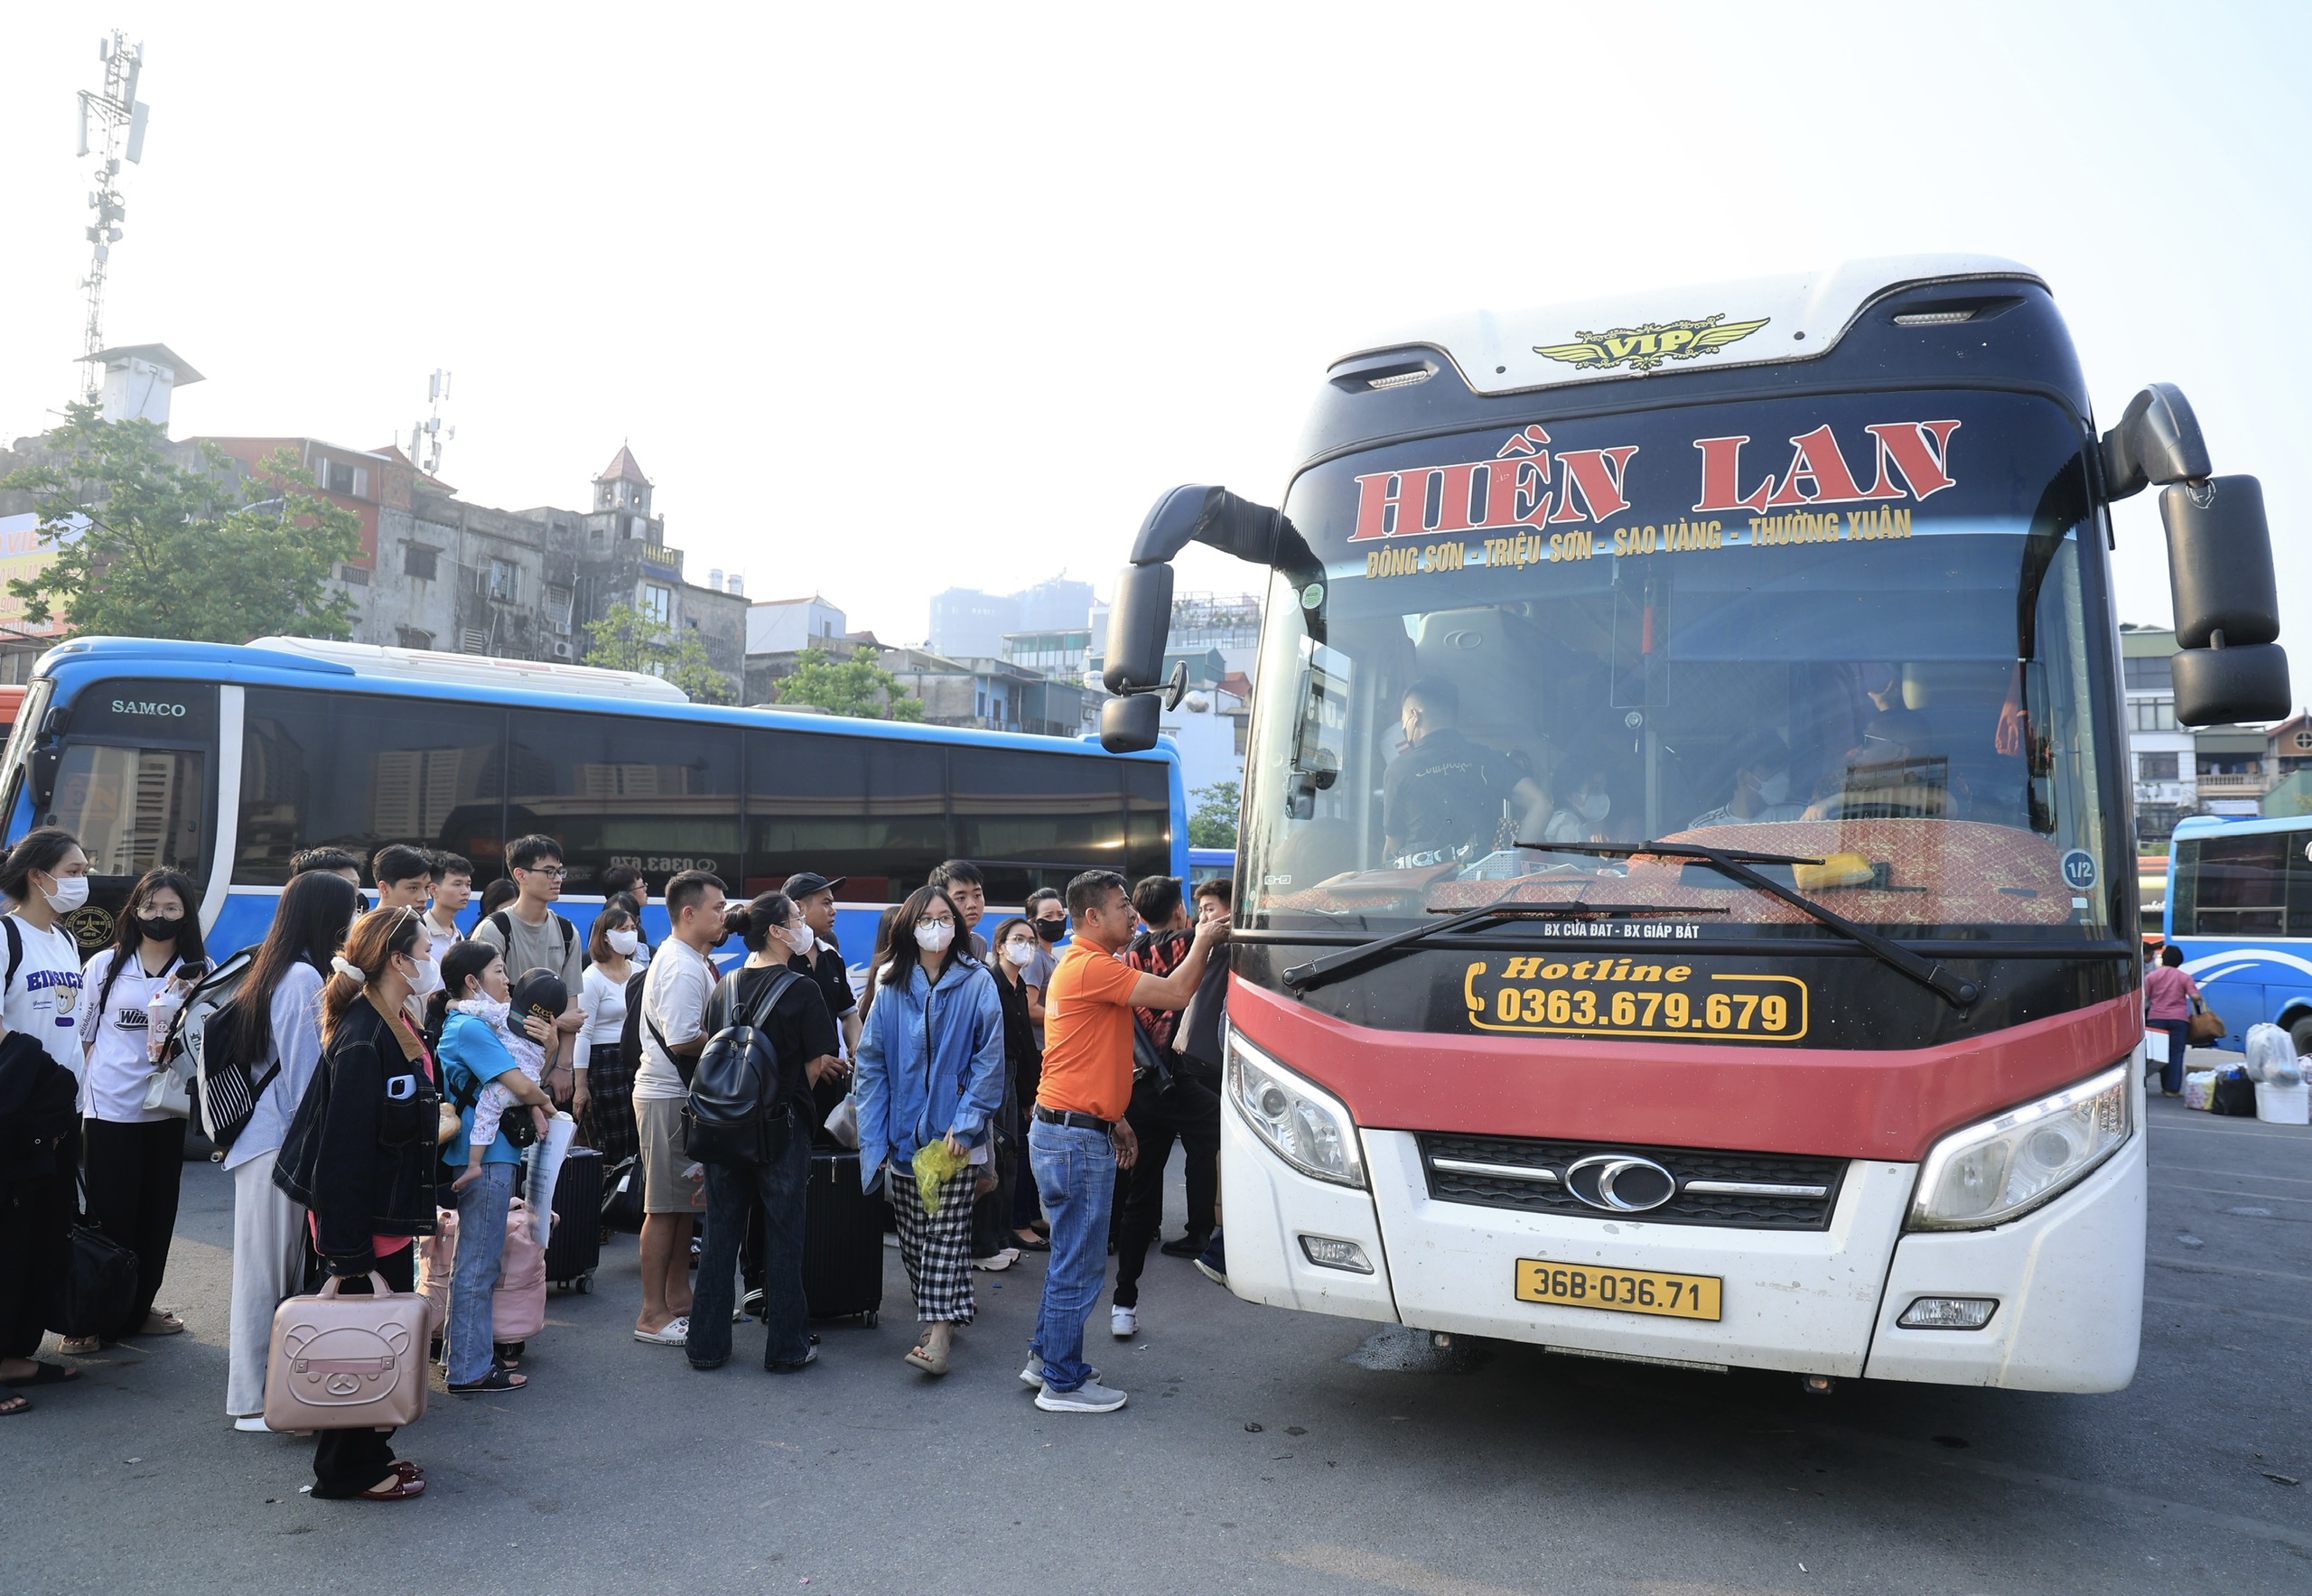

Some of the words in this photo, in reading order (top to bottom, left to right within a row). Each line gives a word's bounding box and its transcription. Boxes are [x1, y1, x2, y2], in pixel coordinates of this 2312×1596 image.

[1603, 330, 1694, 359] VIP
[1347, 425, 1639, 542] HIỀN
[1692, 420, 1962, 515] LAN
[1366, 545, 1418, 579] ĐÔNG
[1424, 542, 1465, 573] SƠN
[1485, 531, 1541, 570] TRIỆU
[1550, 530, 1592, 563] SƠN
[1614, 525, 1656, 556] SAO
[1664, 517, 1721, 553] VÀNG
[1748, 509, 1839, 546] THƯỜNG
[1847, 504, 1912, 540] XUÂN
[112, 699, 186, 717] SAMCO
[2068, 862, 2093, 878] 1/2
[1544, 924, 1560, 936] BX
[1625, 924, 1640, 938] BX
[1644, 921, 1672, 938] GIÁP
[1675, 922, 1700, 938] BÁT
[1500, 957, 1692, 983] Hotline
[121, 1010, 149, 1024] Win
[1497, 987, 1787, 1031] 0363.679.679
[1534, 1268, 1700, 1311] 36B-036.71
